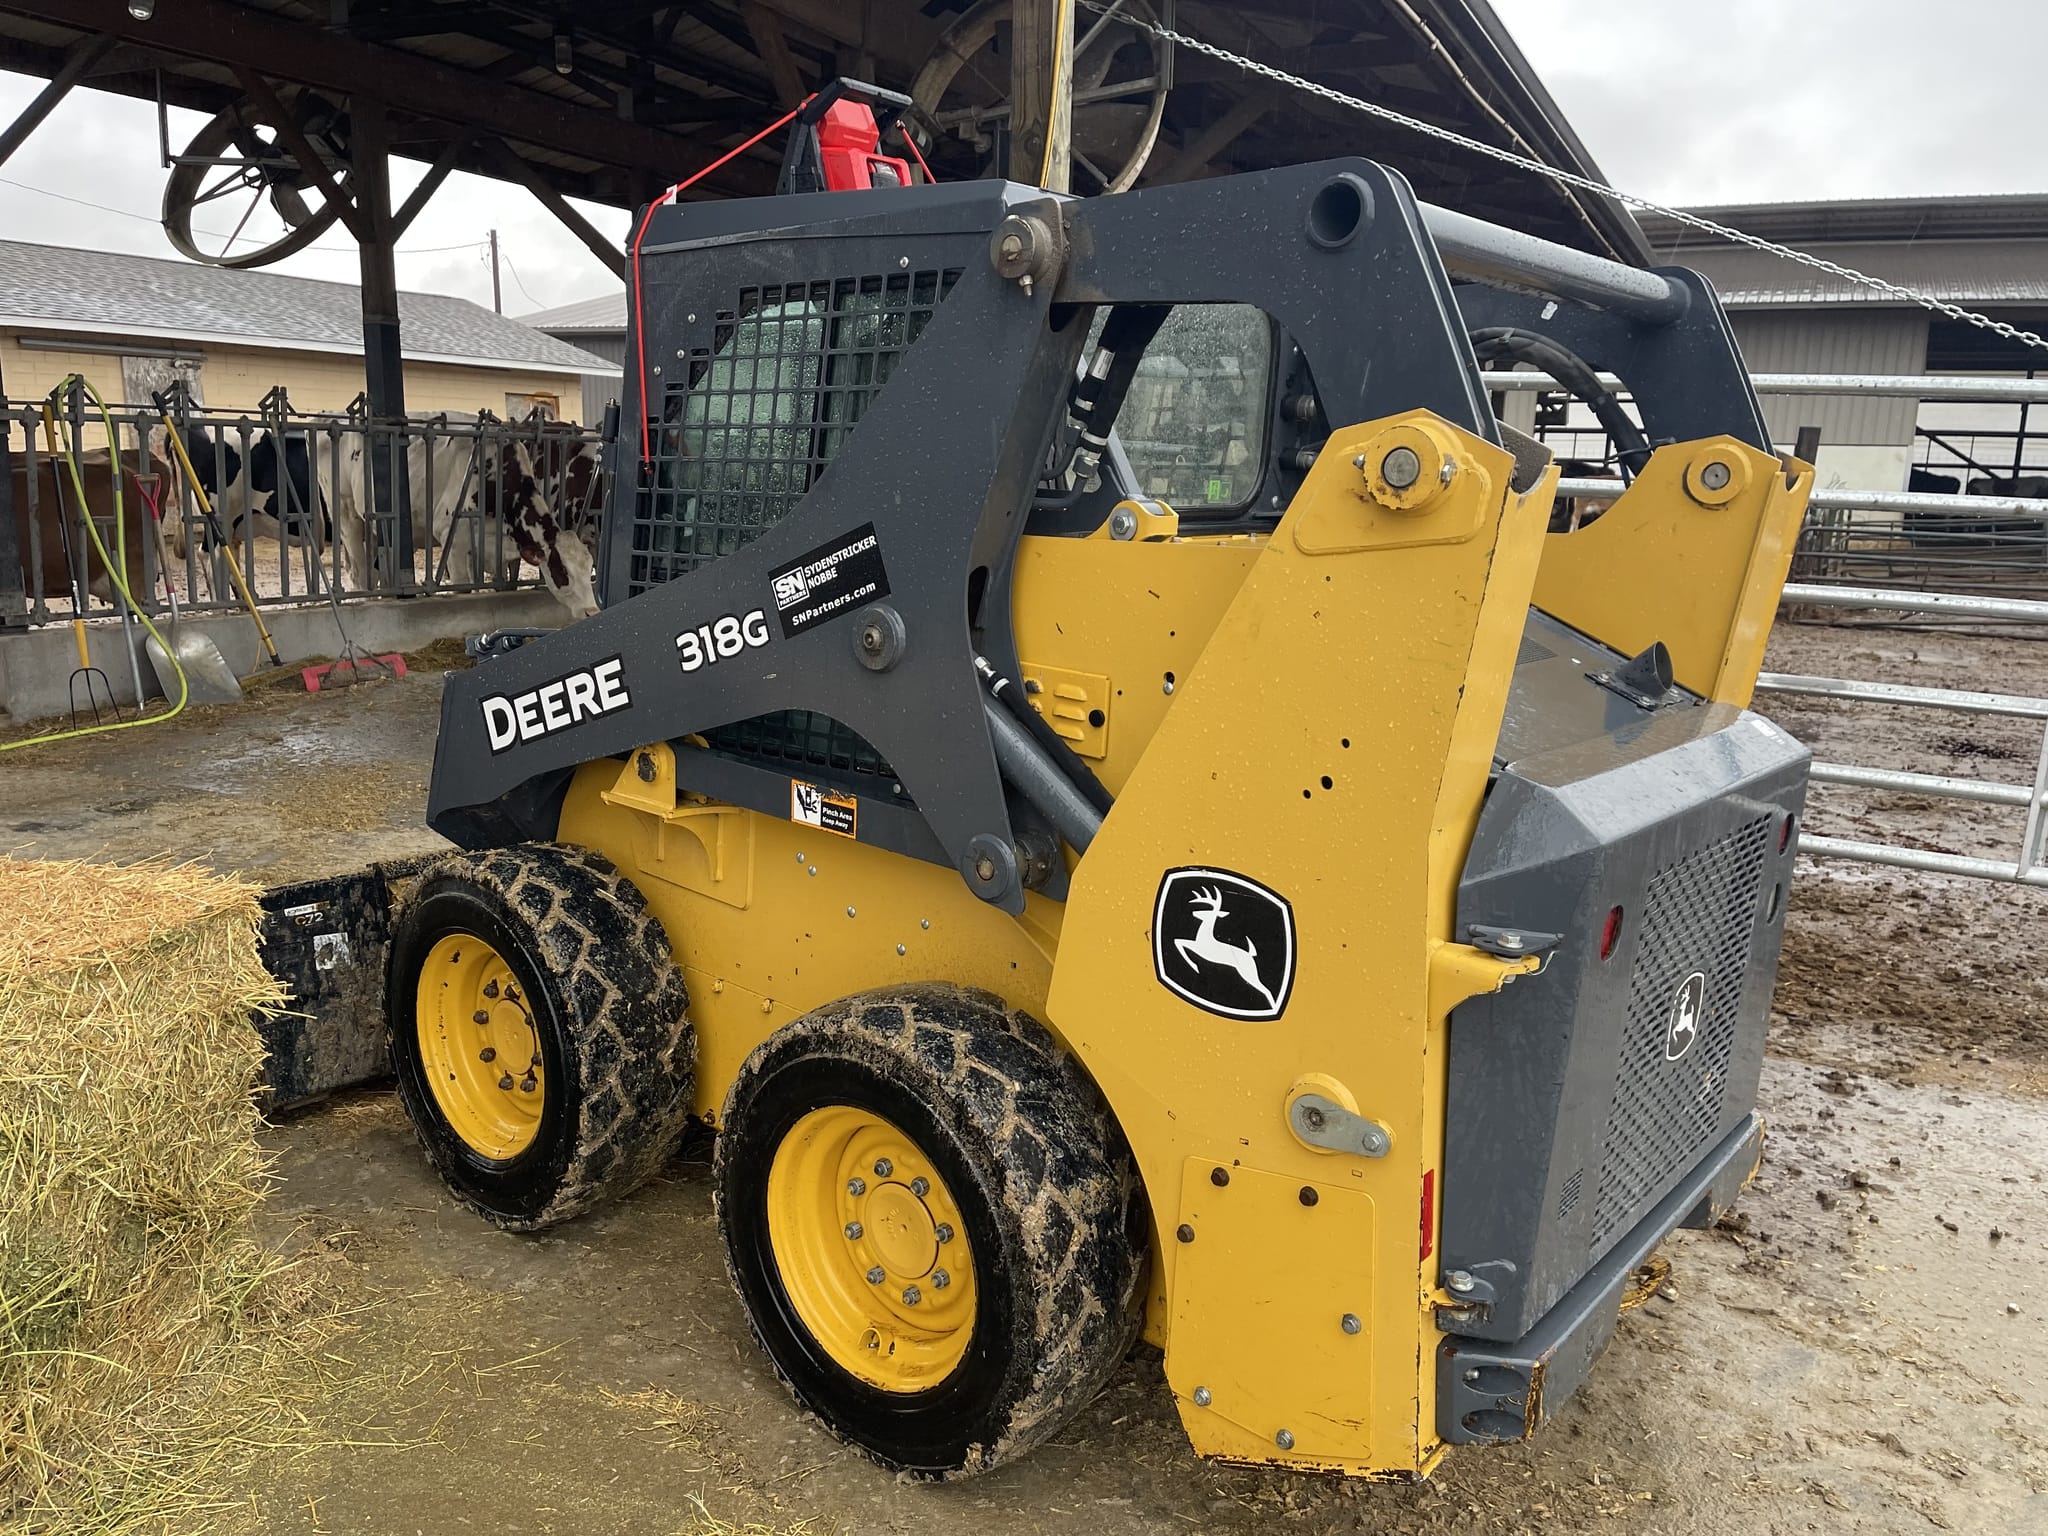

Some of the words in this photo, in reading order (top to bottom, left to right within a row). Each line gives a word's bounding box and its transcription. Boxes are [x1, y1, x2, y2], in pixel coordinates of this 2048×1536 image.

[804, 535, 877, 577] SYDENSTRICKER
[775, 571, 805, 599] SN
[807, 567, 838, 589] NOBBE
[779, 590, 807, 606] PARTNERS
[792, 582, 876, 625] SNPartners.com
[676, 609, 769, 672] 318G
[481, 658, 630, 751] DEERE
[822, 807, 839, 817] Pinch
[839, 811, 853, 821] Area
[835, 820, 849, 830] Away
